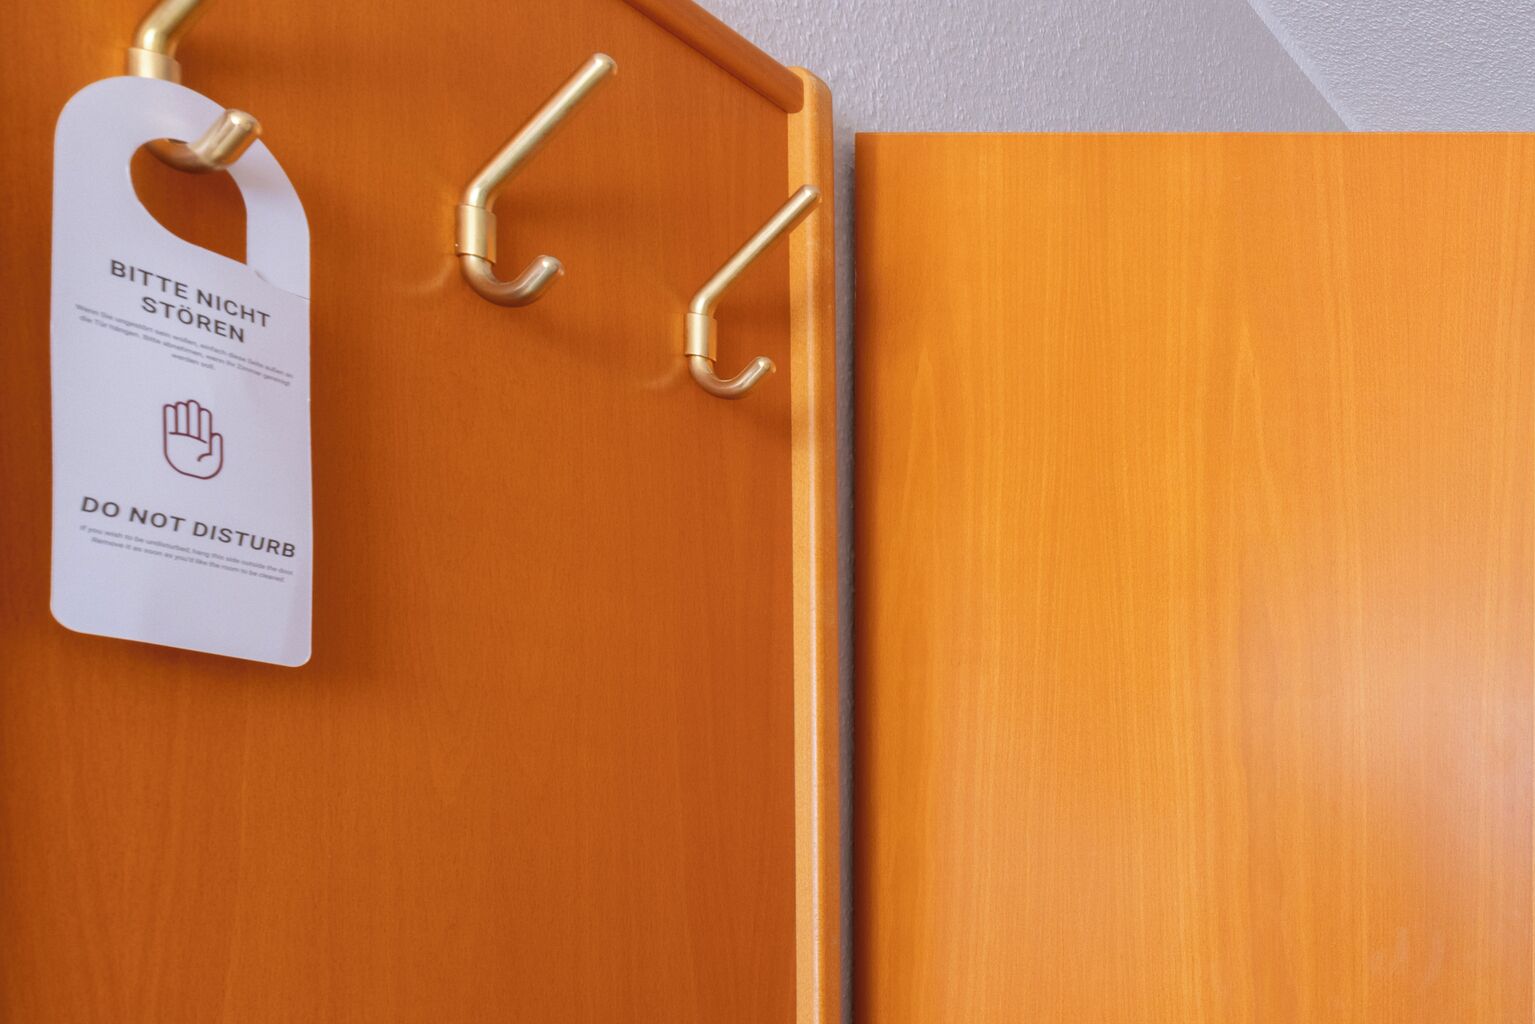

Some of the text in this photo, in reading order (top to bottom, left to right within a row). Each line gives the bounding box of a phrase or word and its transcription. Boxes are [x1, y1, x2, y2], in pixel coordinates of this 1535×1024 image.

[110, 259, 271, 328] BITTE NICHT
[141, 296, 244, 343] STÖREN
[81, 496, 295, 557] DO NOT DISTURB
